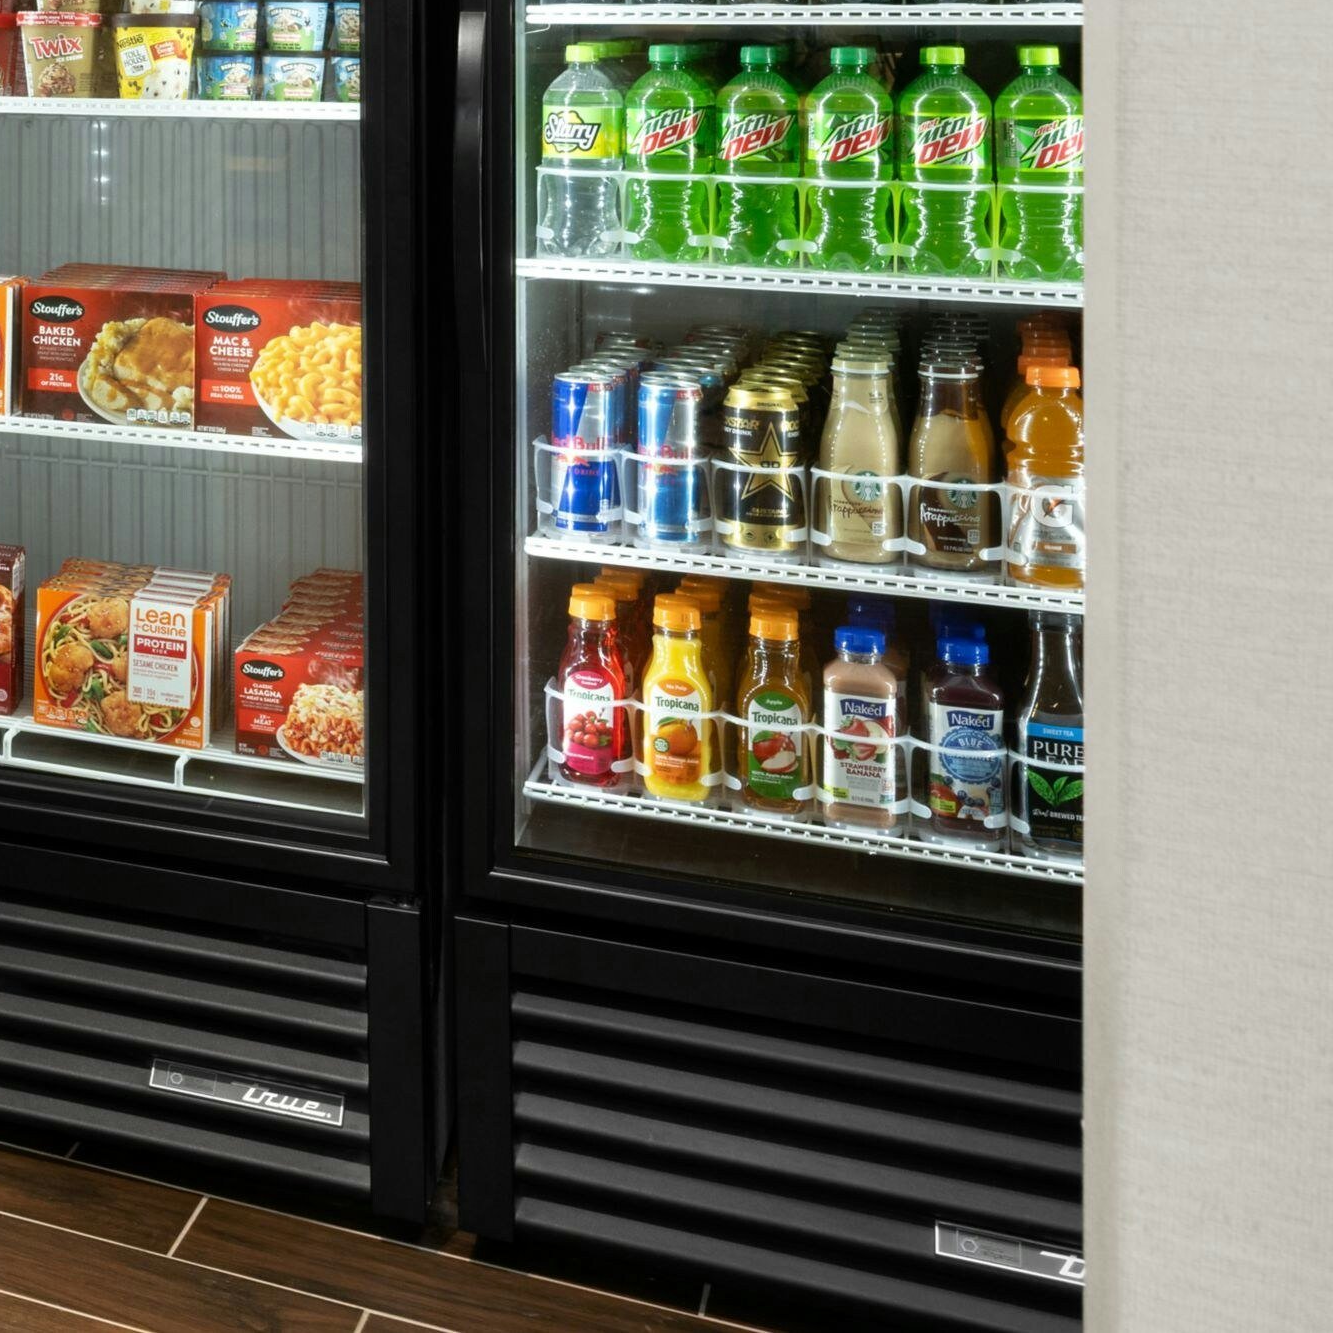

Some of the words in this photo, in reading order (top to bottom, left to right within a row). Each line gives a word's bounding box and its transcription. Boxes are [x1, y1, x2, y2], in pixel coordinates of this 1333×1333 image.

[918, 118, 939, 132] diet
[1035, 120, 1058, 138] diet
[32, 301, 84, 317] Stouffer's
[205, 311, 260, 327] Stouffer's
[39, 325, 75, 337] BAKED
[32, 335, 82, 347] CHICKEN
[212, 335, 240, 346] MAC
[241, 337, 250, 347] &
[209, 346, 254, 358] CHEESE
[135, 607, 187, 629] Lean
[136, 637, 185, 653] PROTEIN
[155, 661, 179, 672] CHICKEN
[242, 663, 284, 678] Stouffer's
[243, 687, 283, 700] LASAGNA
[654, 696, 700, 712] Tropicana
[844, 702, 883, 717] Naked
[751, 711, 799, 726] Tropicana
[951, 713, 991, 728] Naked
[1061, 729, 1075, 737] TEA
[957, 737, 984, 749] BLUE
[1033, 740, 1085, 759] PURE
[840, 761, 887, 774] STRAWBERRY
[846, 768, 882, 780] BANANA
[1049, 810, 1075, 821] BREWED
